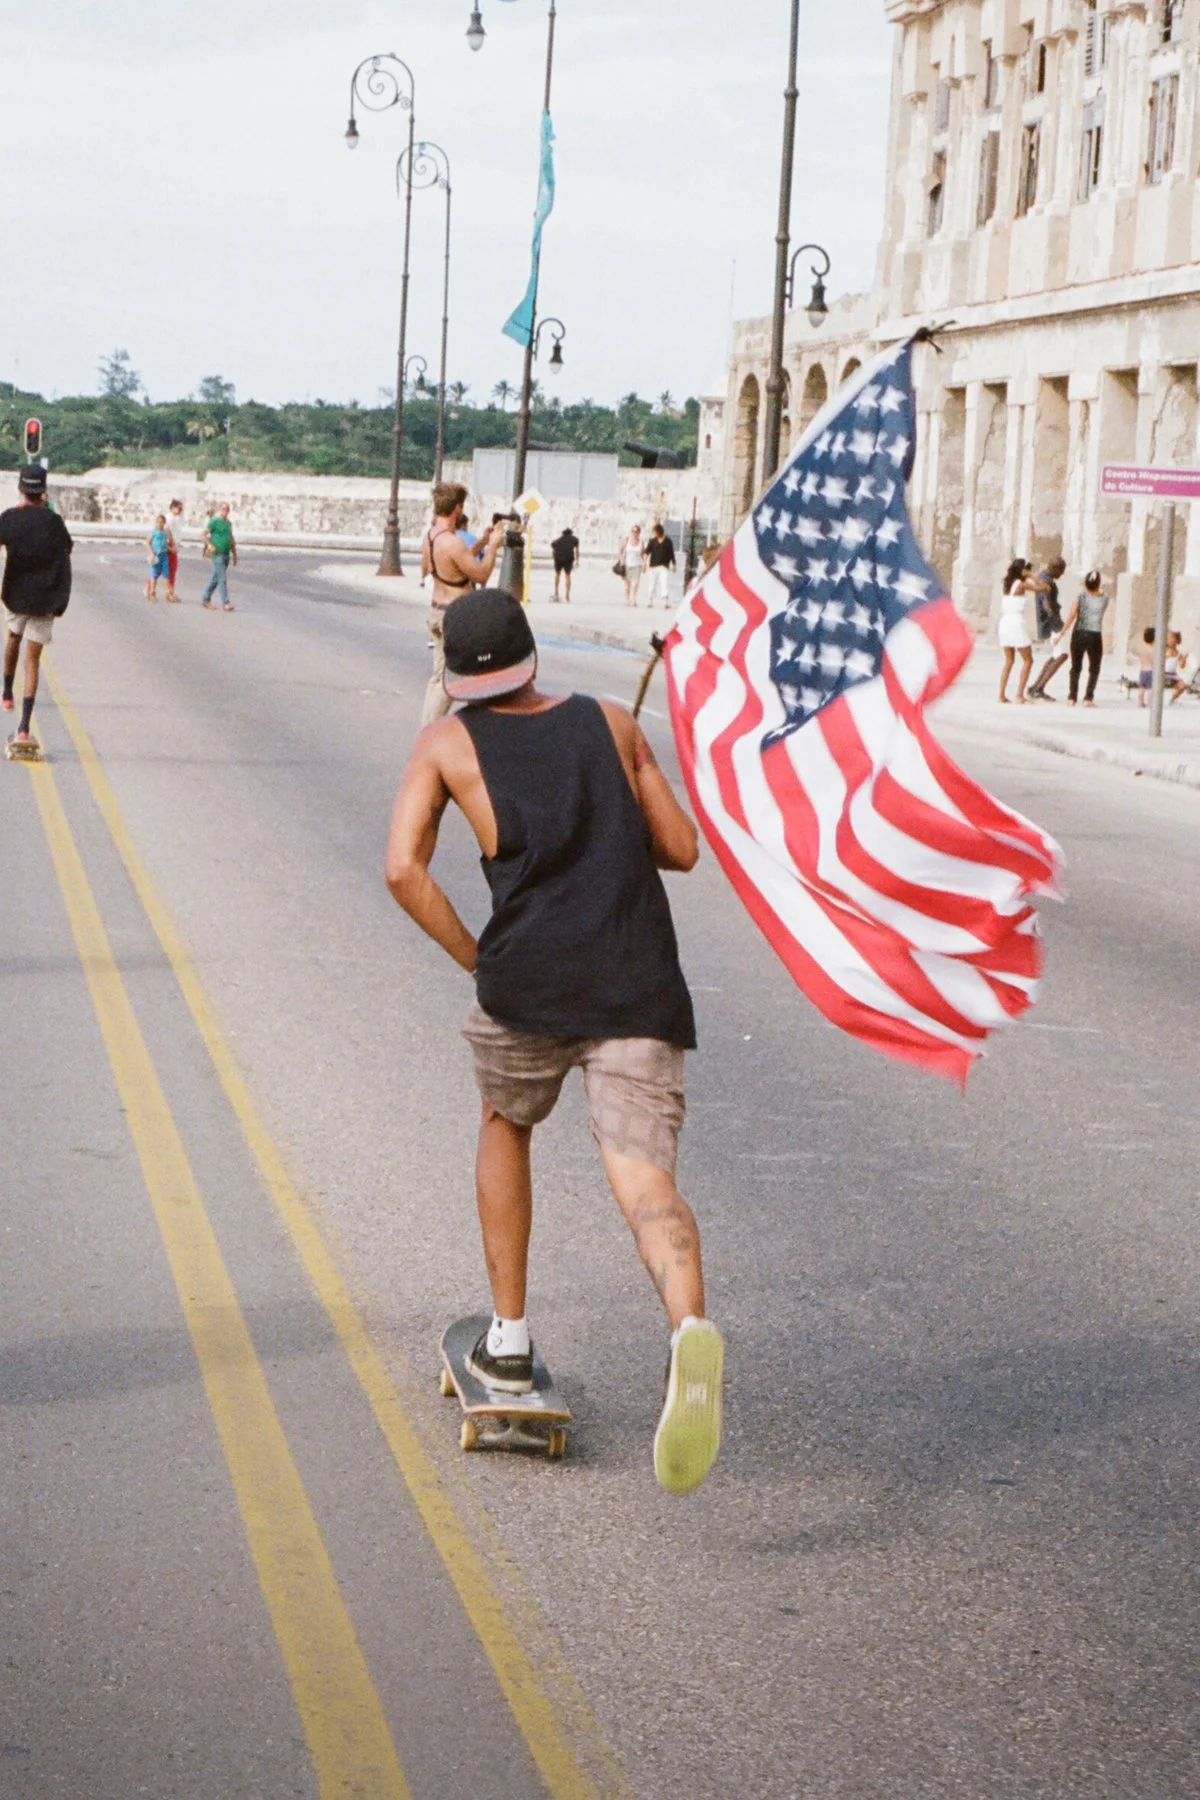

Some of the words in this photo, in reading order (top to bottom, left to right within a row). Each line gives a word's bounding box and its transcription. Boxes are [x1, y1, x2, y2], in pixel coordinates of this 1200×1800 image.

[1105, 469, 1137, 479] Centro
[1104, 482, 1116, 491] de
[1118, 482, 1154, 493] Cultura
